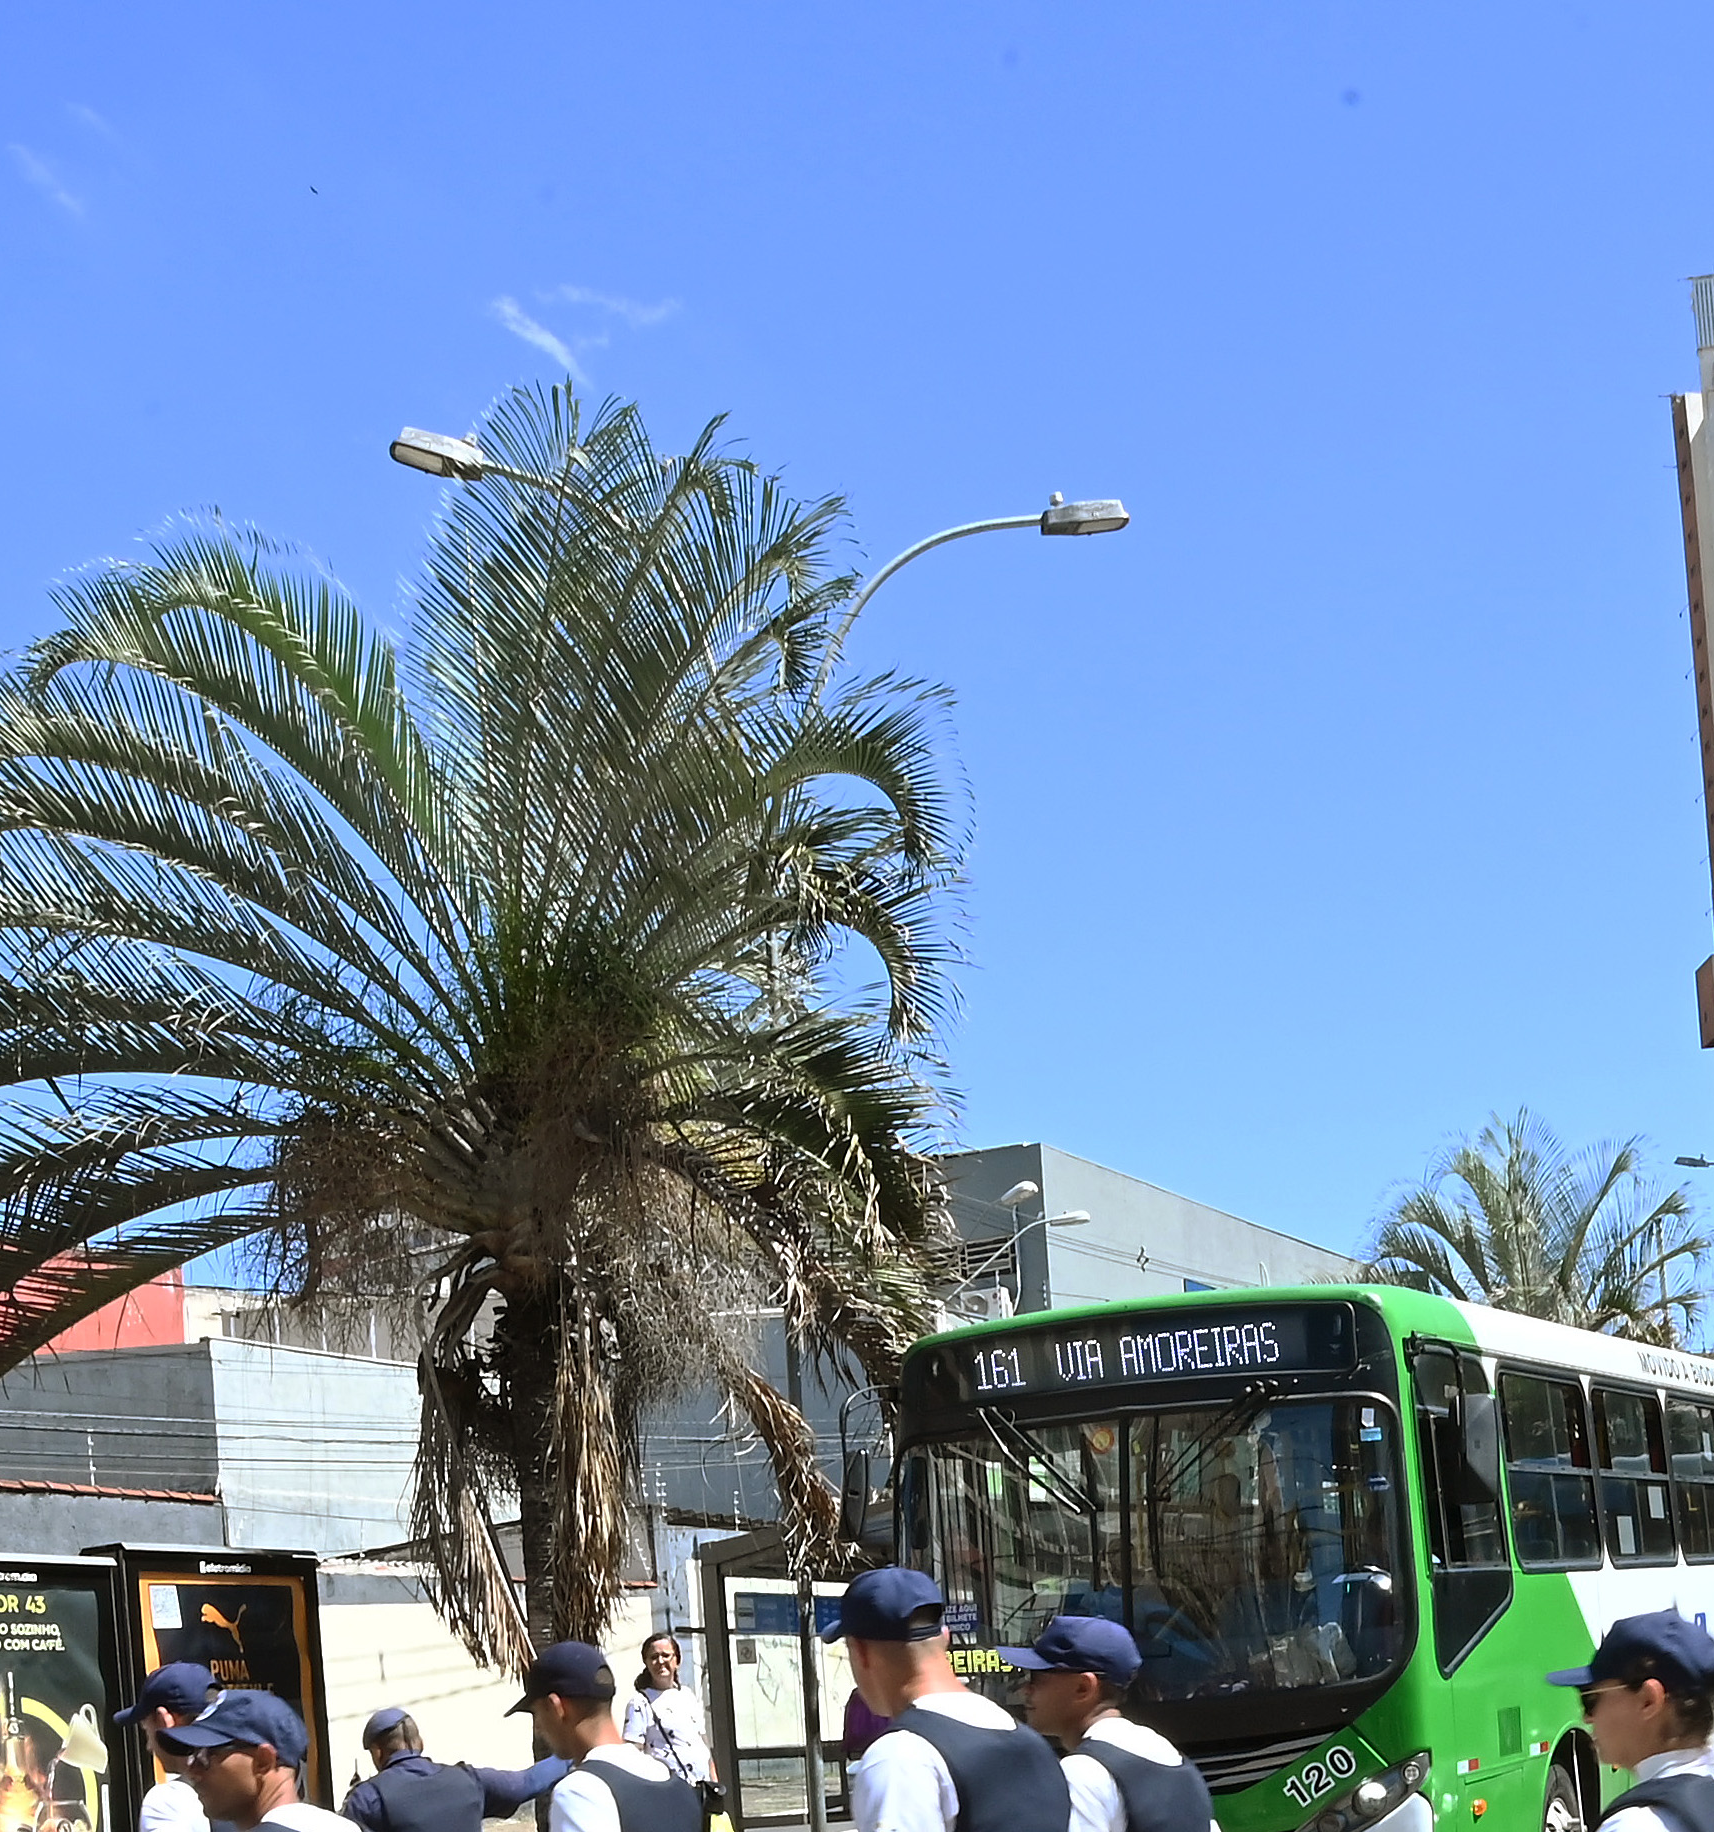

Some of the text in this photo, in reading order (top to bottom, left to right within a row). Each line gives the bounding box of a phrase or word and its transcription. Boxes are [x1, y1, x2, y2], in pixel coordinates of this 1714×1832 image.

[974, 1322, 1279, 1391] 161 VIA AMOREIRAS
[25, 1595, 46, 1613] 43
[11, 1623, 61, 1637] SOZINHO,
[3, 1639, 30, 1651] COM
[210, 1659, 250, 1681] PUMA
[1283, 1745, 1356, 1807] 120
